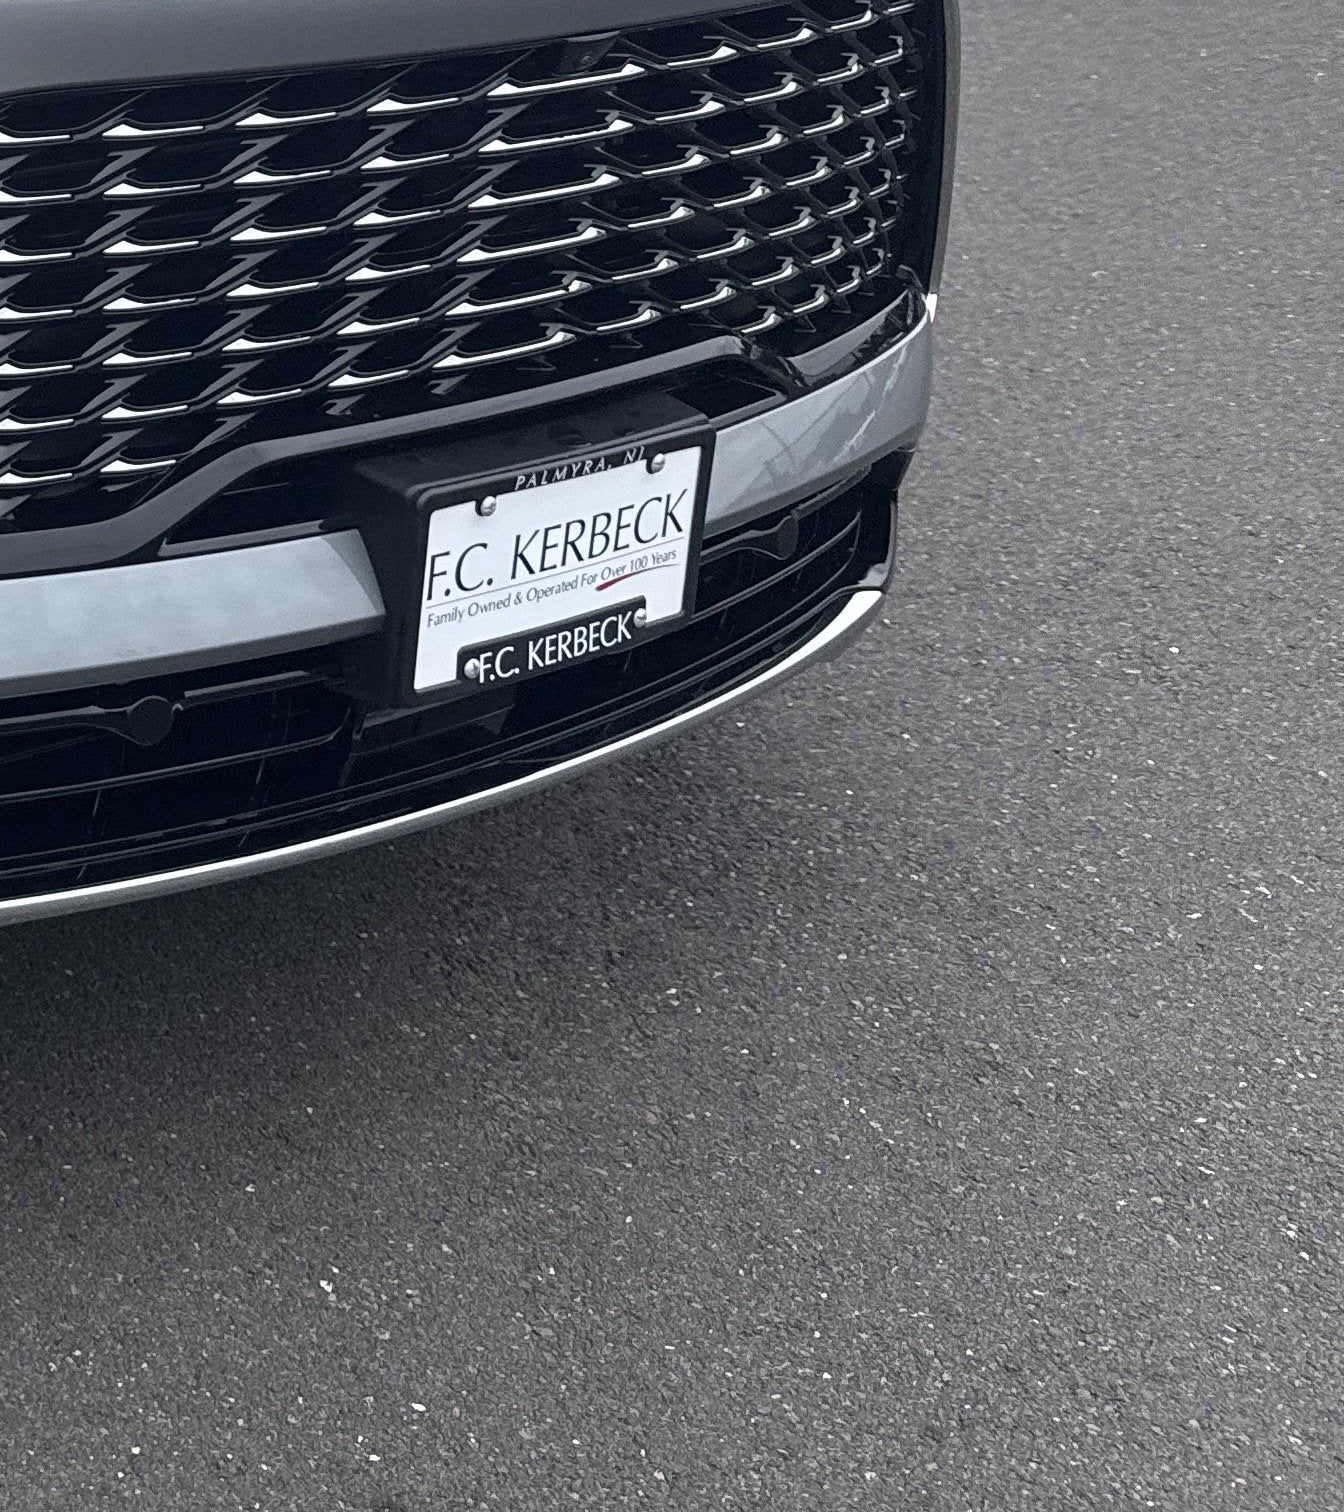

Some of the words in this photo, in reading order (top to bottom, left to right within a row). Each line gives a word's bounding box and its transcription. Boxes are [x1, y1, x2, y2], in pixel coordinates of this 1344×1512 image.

[426, 542, 494, 601] F.C.
[510, 488, 688, 580] KERBECK
[427, 606, 465, 628] Family
[467, 592, 512, 617] Owned
[513, 591, 524, 606] &
[526, 574, 579, 603] Operated
[580, 572, 598, 588] For
[600, 564, 627, 581] Over
[630, 554, 649, 572] 100
[651, 549, 678, 566] Years
[478, 645, 520, 684] F.C.
[527, 610, 633, 671] KERBECK
